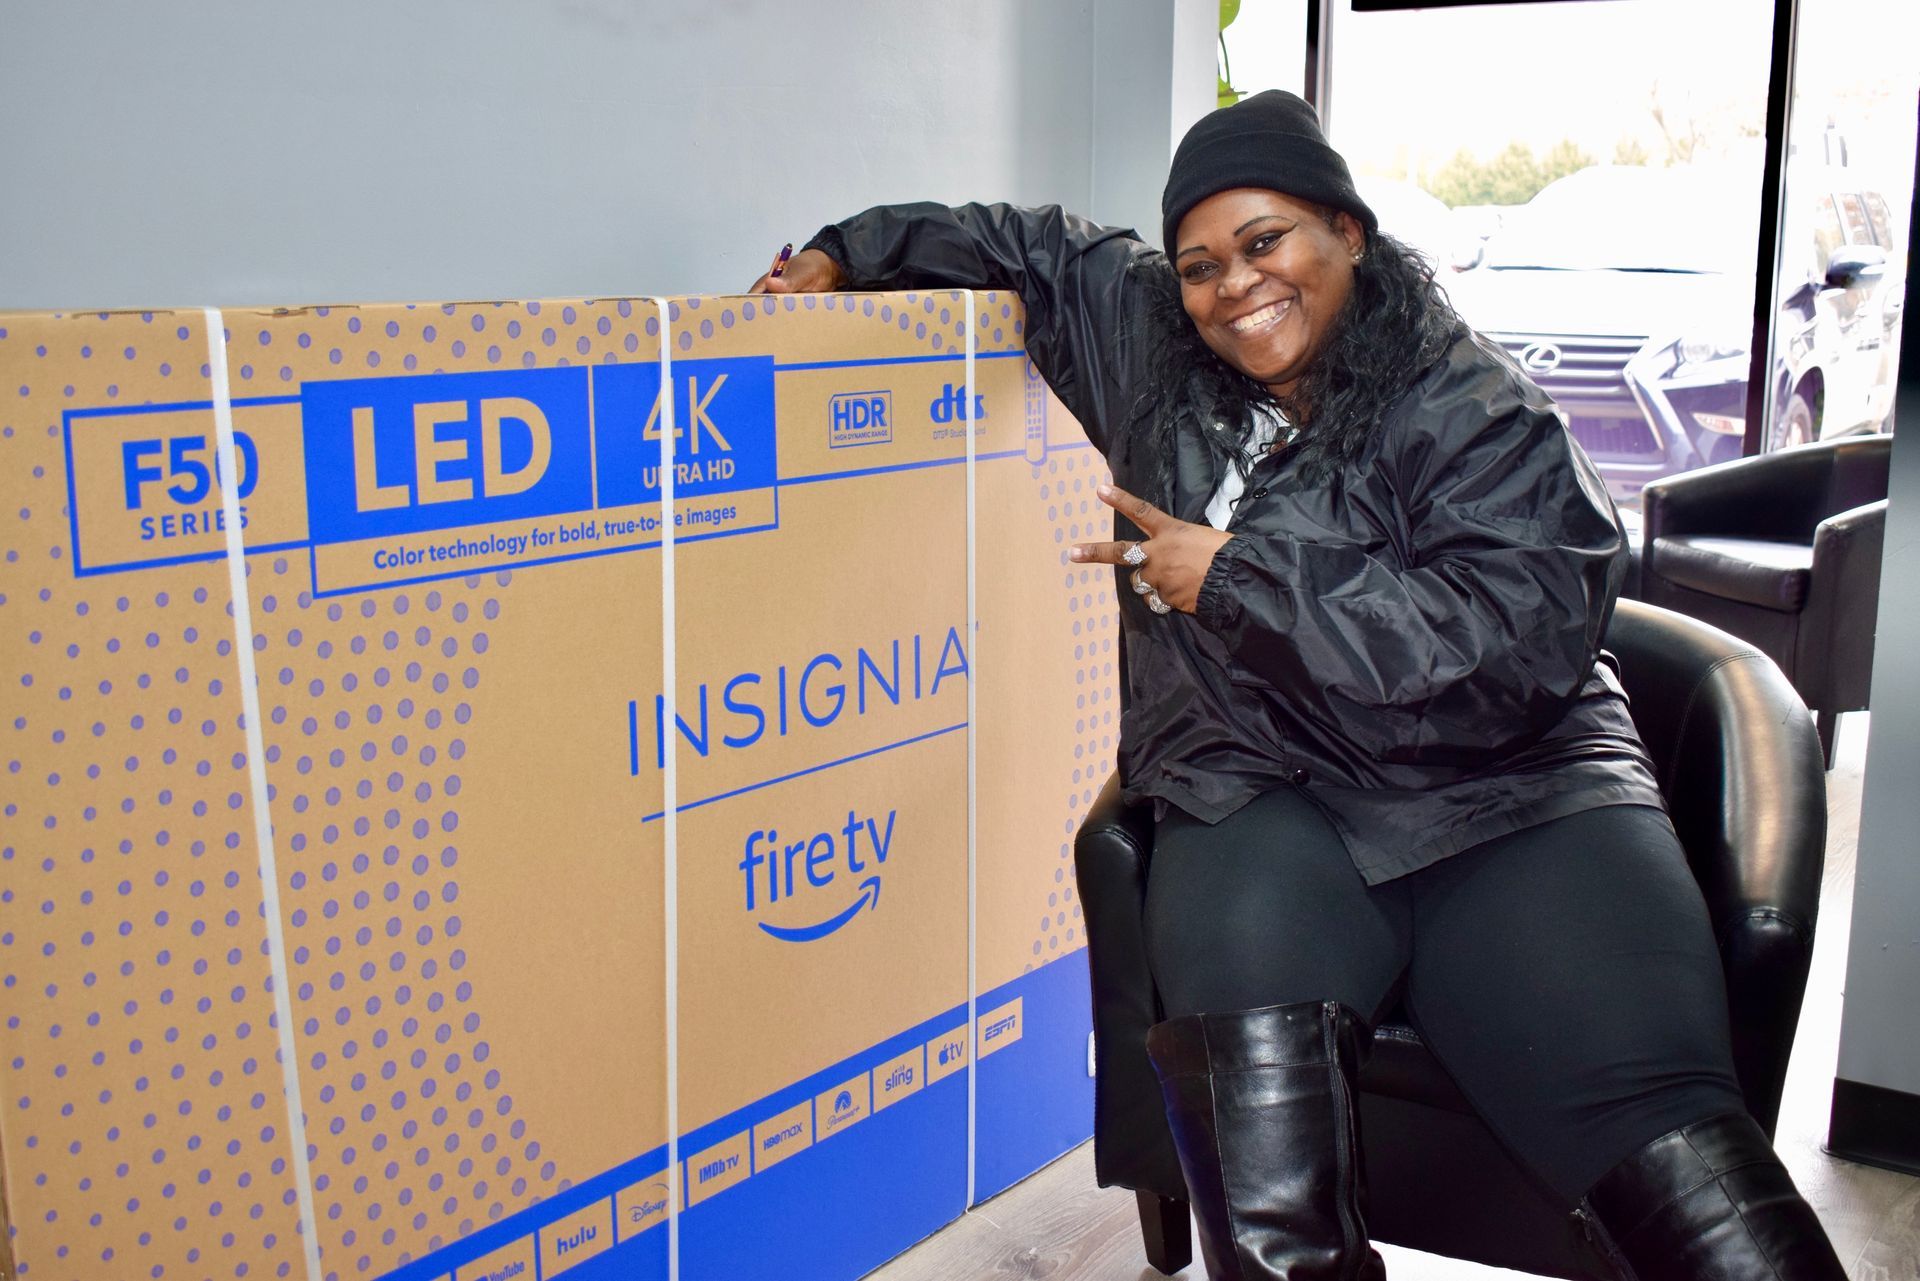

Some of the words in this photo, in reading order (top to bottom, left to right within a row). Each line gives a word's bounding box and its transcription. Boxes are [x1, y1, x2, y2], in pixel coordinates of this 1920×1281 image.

[643, 374, 733, 457] 4K
[833, 397, 887, 431] HDR
[847, 431, 871, 441] DYNAMIC
[122, 431, 259, 510] F50
[351, 397, 552, 513] LED
[643, 461, 704, 489] URA
[707, 458, 736, 481] HD
[373, 545, 424, 569] Color
[428, 533, 528, 561] technology
[531, 527, 556, 548] for
[559, 521, 600, 544] bold,
[686, 505, 737, 527] images
[628, 626, 969, 777] INSIGNIA
[984, 1014, 1016, 1042] ESPN
[949, 1040, 964, 1061] tv
[884, 1067, 913, 1092] sling
[556, 1224, 597, 1257] hulu
